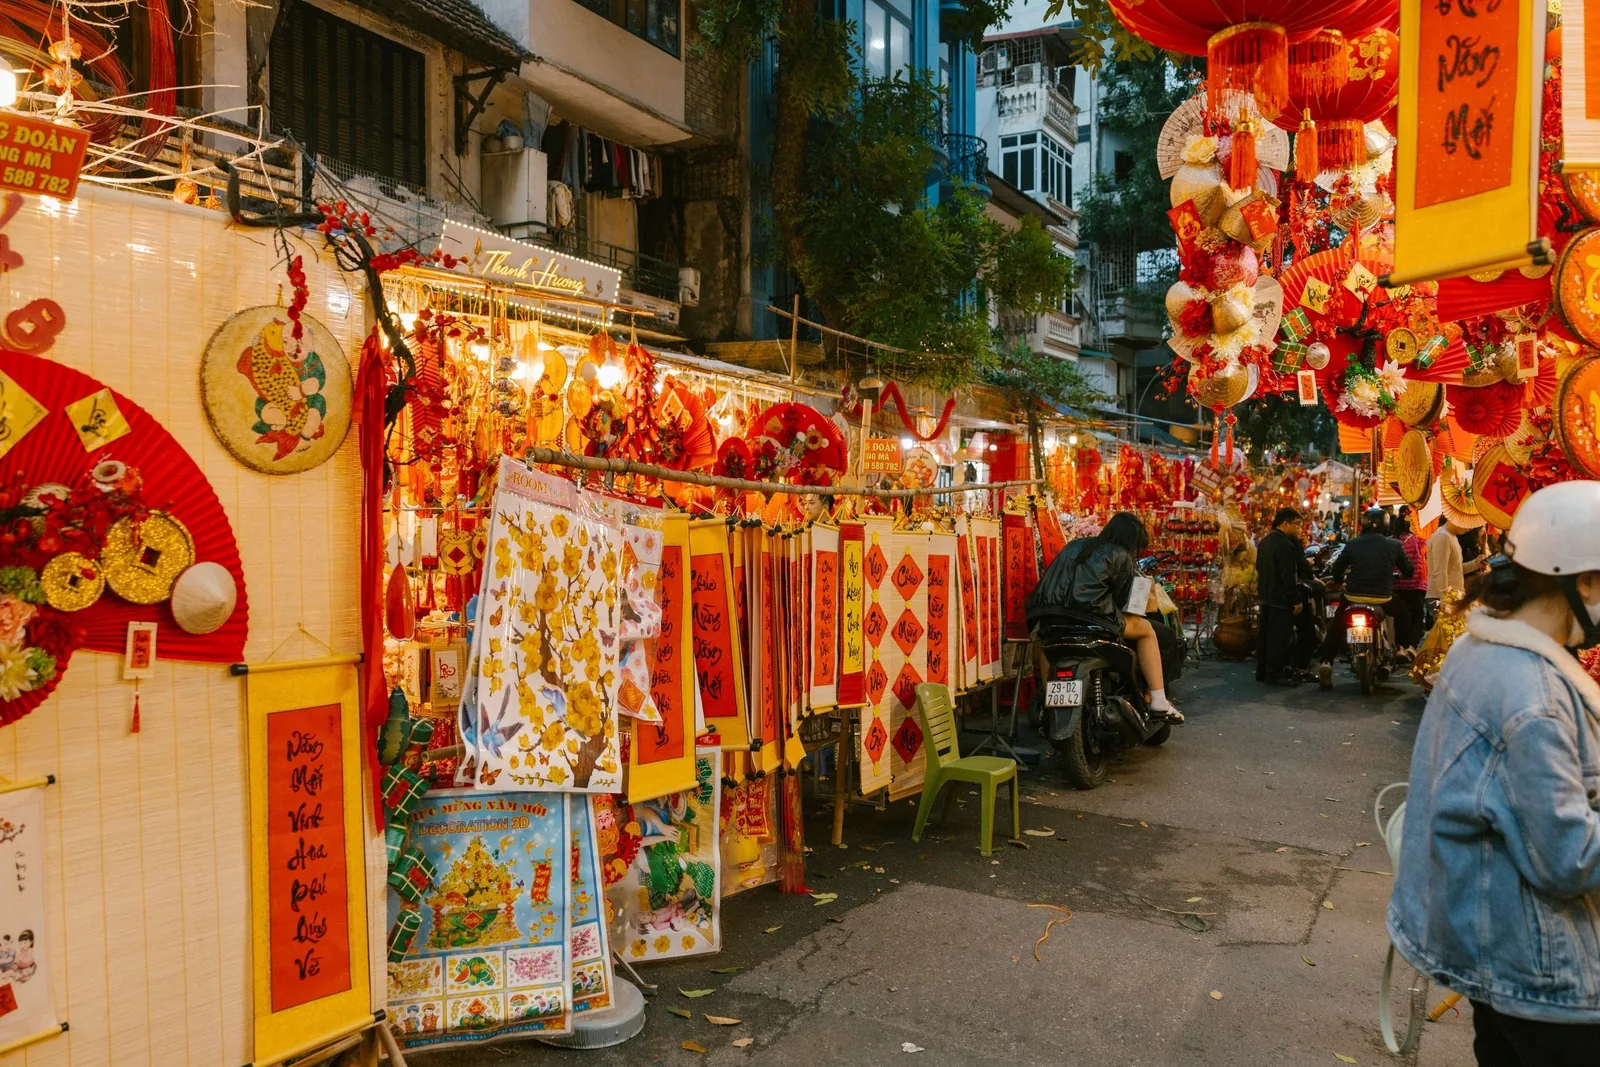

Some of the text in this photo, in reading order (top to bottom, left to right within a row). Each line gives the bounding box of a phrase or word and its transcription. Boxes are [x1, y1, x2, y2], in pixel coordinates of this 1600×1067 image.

[1438, 34, 1499, 92] Năm
[1441, 95, 1496, 160] Mới
[13, 128, 78, 155] ĐOÀN
[3, 167, 70, 194] 588 782
[480, 249, 533, 279] Thanh
[872, 442, 897, 451] ĐOÀN
[871, 462, 884, 470] 588
[886, 463, 898, 471] 782
[512, 471, 547, 494] ROOM
[897, 565, 918, 588] Chúc
[898, 621, 918, 644] Mừng
[1047, 694, 1079, 706] 708.42
[1051, 682, 1077, 694] 29-D2
[287, 730, 324, 761] Năm
[288, 764, 323, 796] Mới
[288, 802, 324, 833] Vinh
[441, 798, 482, 815] MỪNG
[486, 797, 518, 811] NĂM
[521, 801, 548, 817] MỚI
[418, 816, 530, 836] DECORATION 3D
[286, 837, 328, 871] Hoa
[291, 872, 327, 912] Phú
